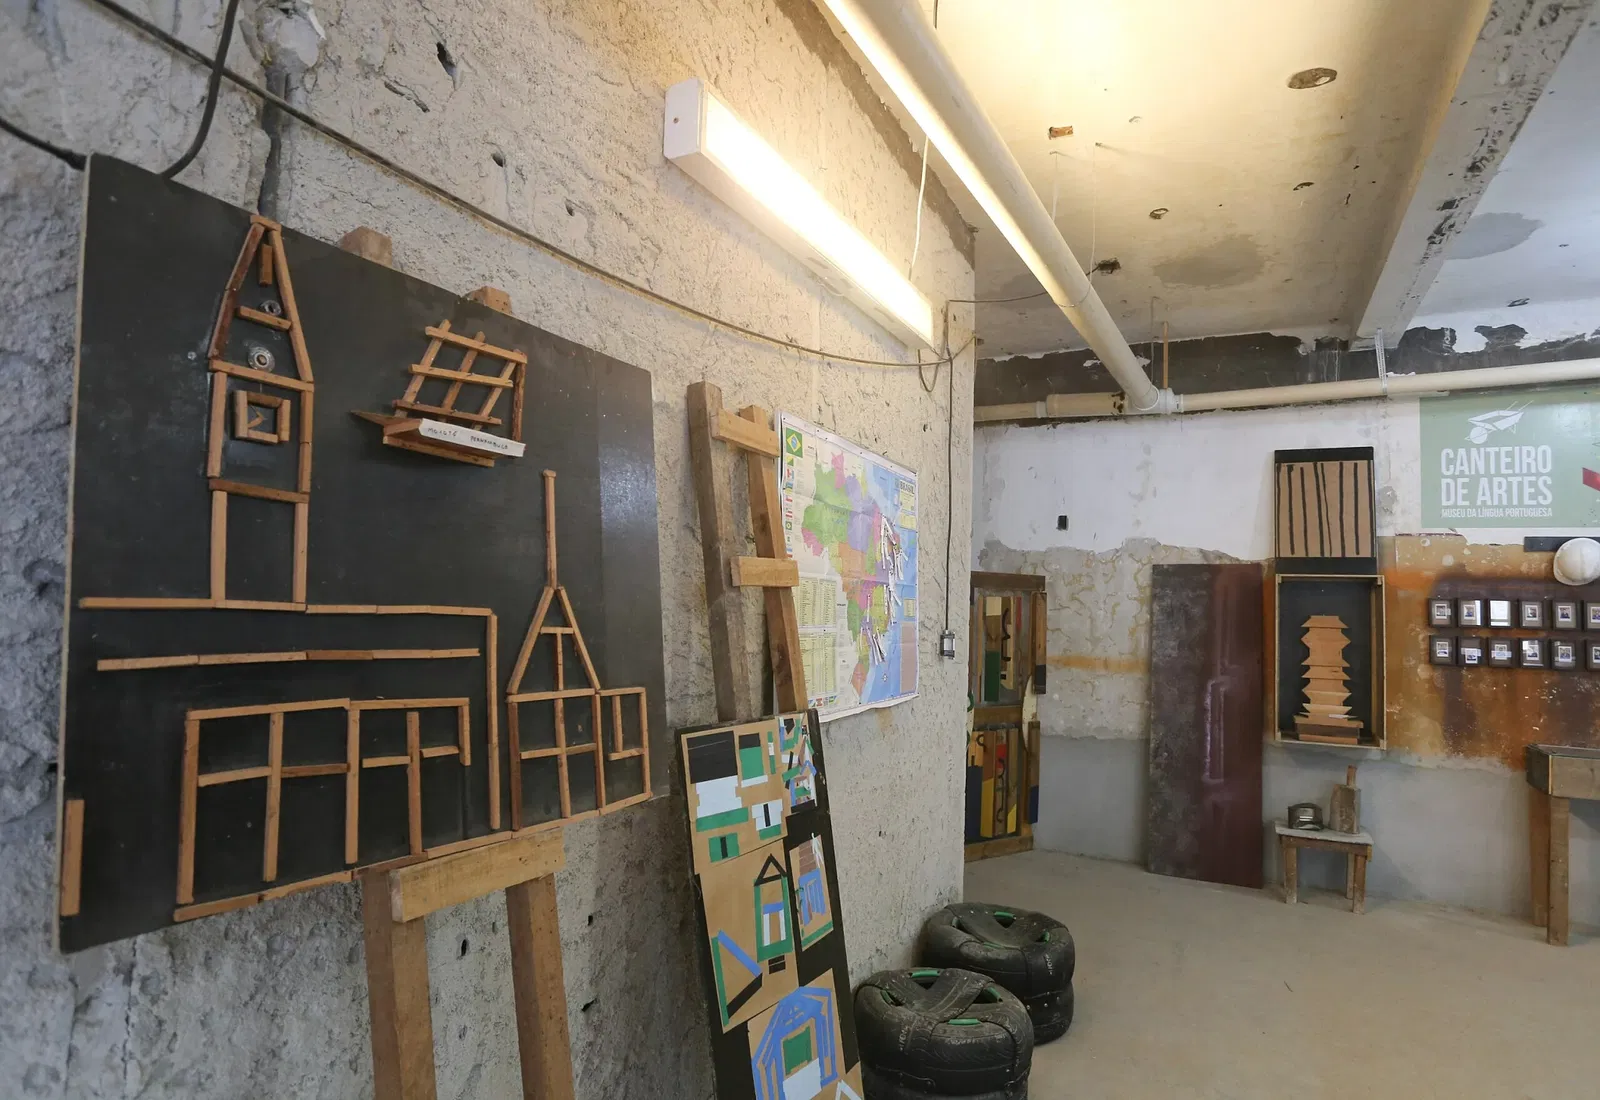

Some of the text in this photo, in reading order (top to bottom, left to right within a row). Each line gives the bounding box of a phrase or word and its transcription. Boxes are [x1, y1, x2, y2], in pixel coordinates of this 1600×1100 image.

[1441, 445, 1552, 476] CANTEIRO
[1441, 476, 1553, 506] DE ARTES
[1441, 506, 1553, 518] MUSEU DA LÍNGUA PORTUGUESA
